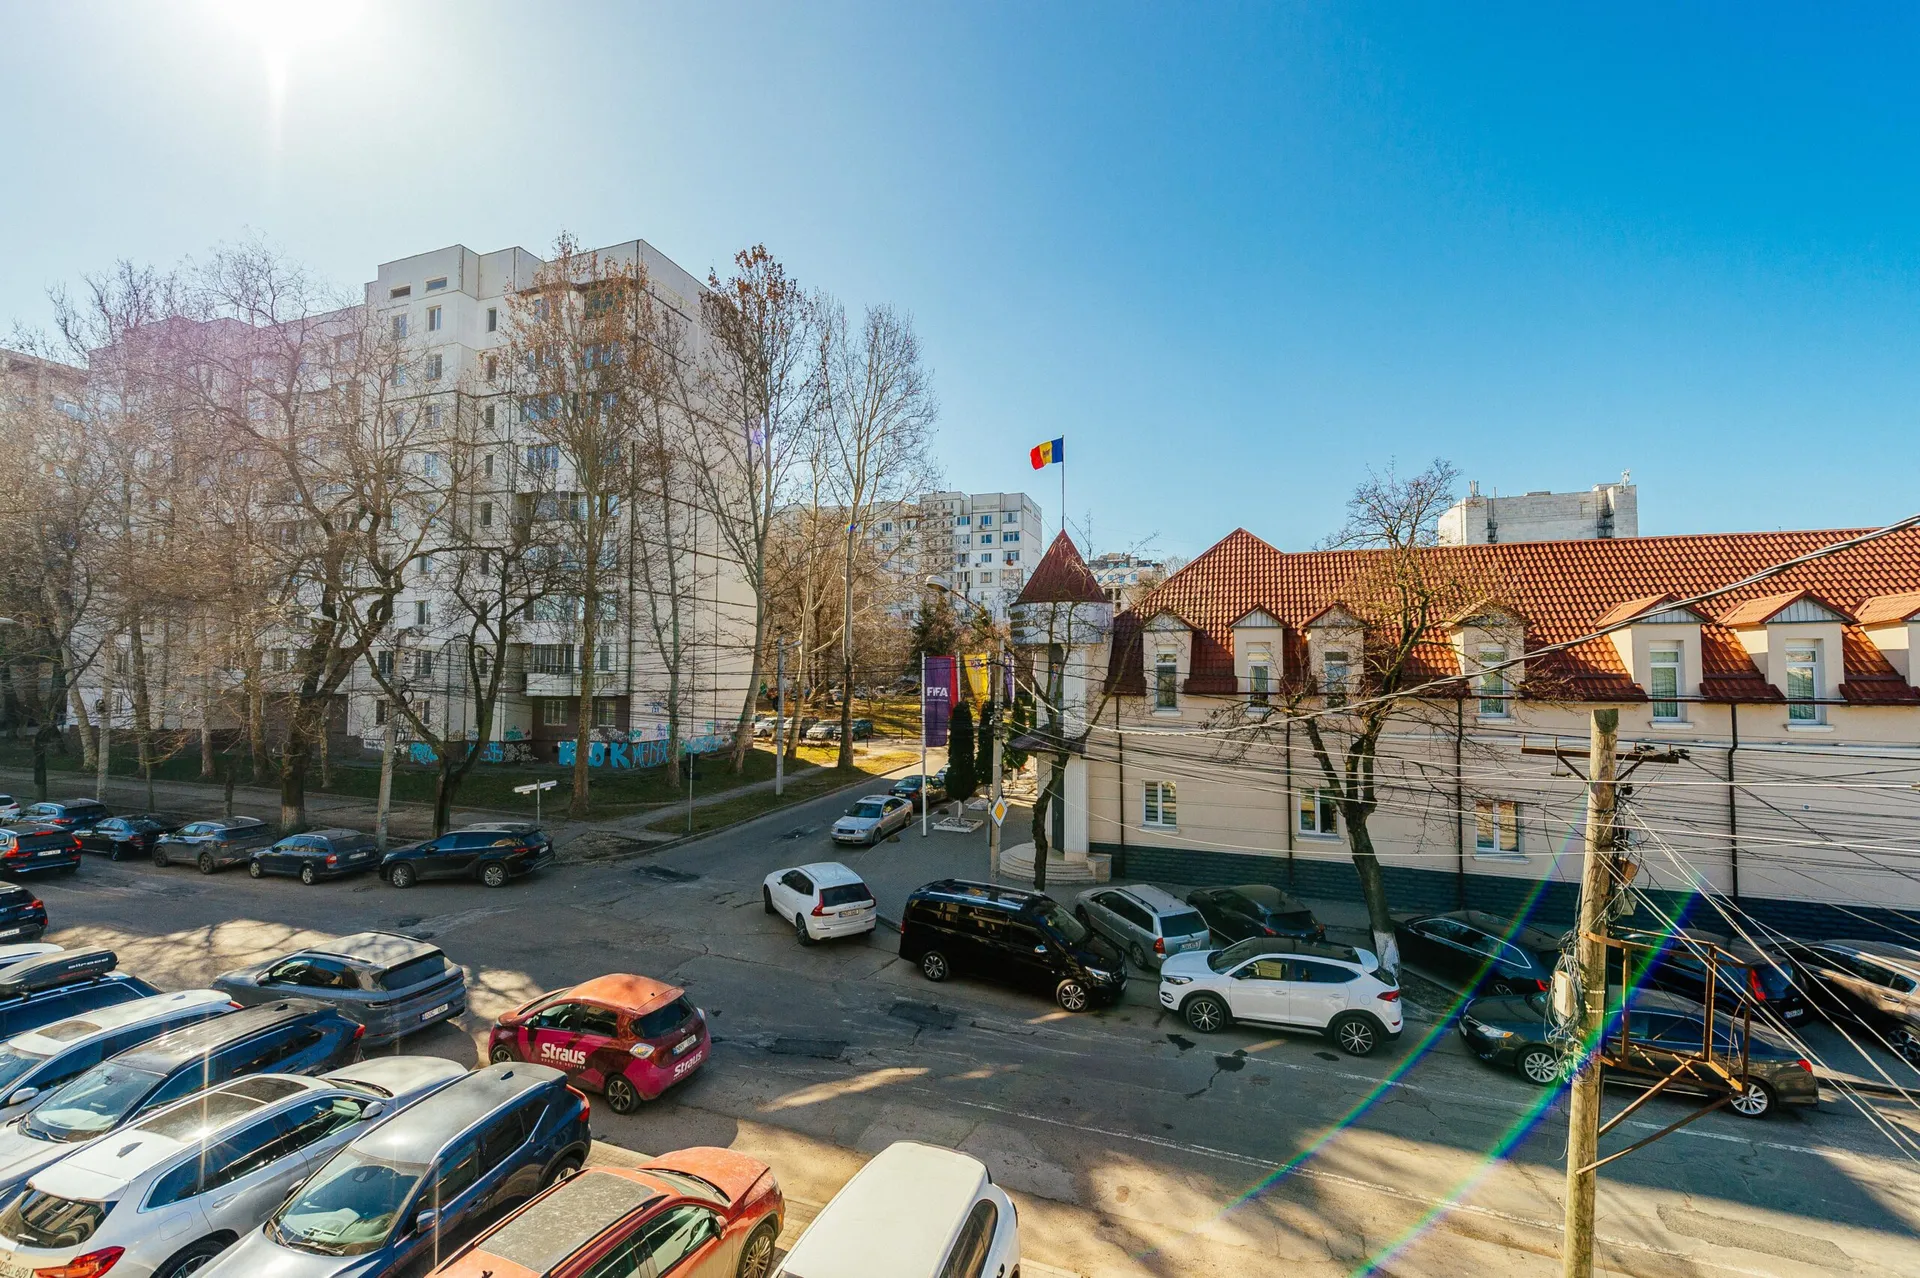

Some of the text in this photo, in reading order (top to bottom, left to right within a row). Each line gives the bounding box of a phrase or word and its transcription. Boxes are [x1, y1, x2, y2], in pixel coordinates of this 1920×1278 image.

[927, 687, 948, 697] FIFA
[541, 1043, 587, 1065] Straus
[673, 1050, 703, 1078] Straus
